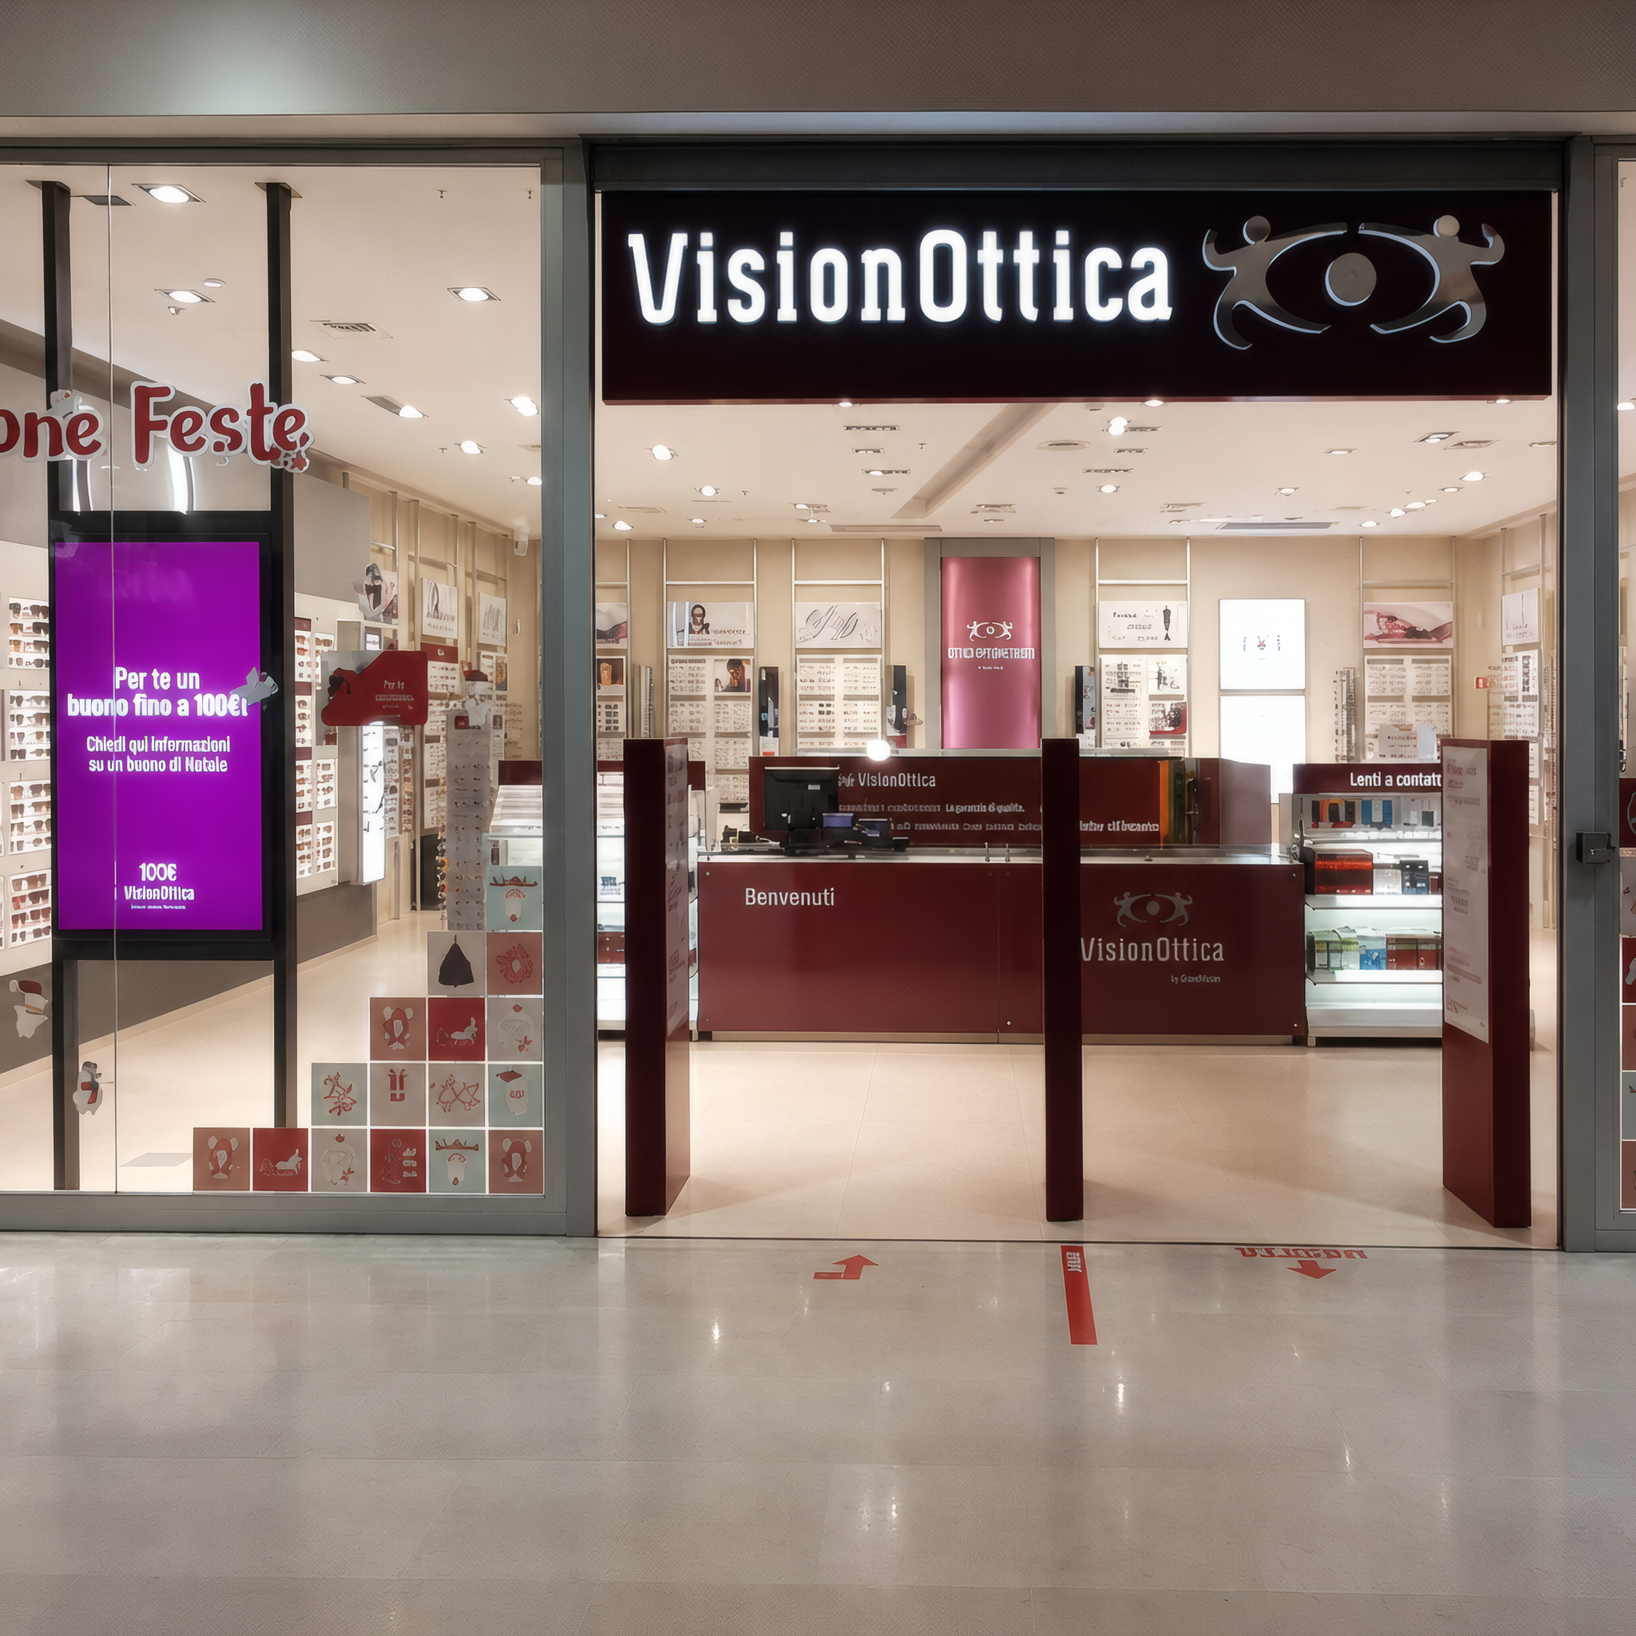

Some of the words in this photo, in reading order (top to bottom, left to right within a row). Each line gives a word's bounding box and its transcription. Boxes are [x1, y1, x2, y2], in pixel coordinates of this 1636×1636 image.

[627, 229, 1173, 325] VisionOttica
[132, 382, 307, 466] Feste
[114, 666, 147, 690] Per
[151, 668, 171, 690] te
[176, 671, 200, 690] un
[67, 693, 129, 717] buono
[133, 693, 172, 717] fino
[176, 700, 190, 717] a
[88, 759, 104, 772] su
[107, 759, 124, 772] un
[126, 755, 166, 772] buono
[858, 772, 936, 787] VisionOttica
[1350, 771, 1381, 787] Lenti
[1384, 774, 1394, 787] a
[745, 887, 835, 906] Benvenuti
[1080, 937, 1224, 962] VisionOttica
